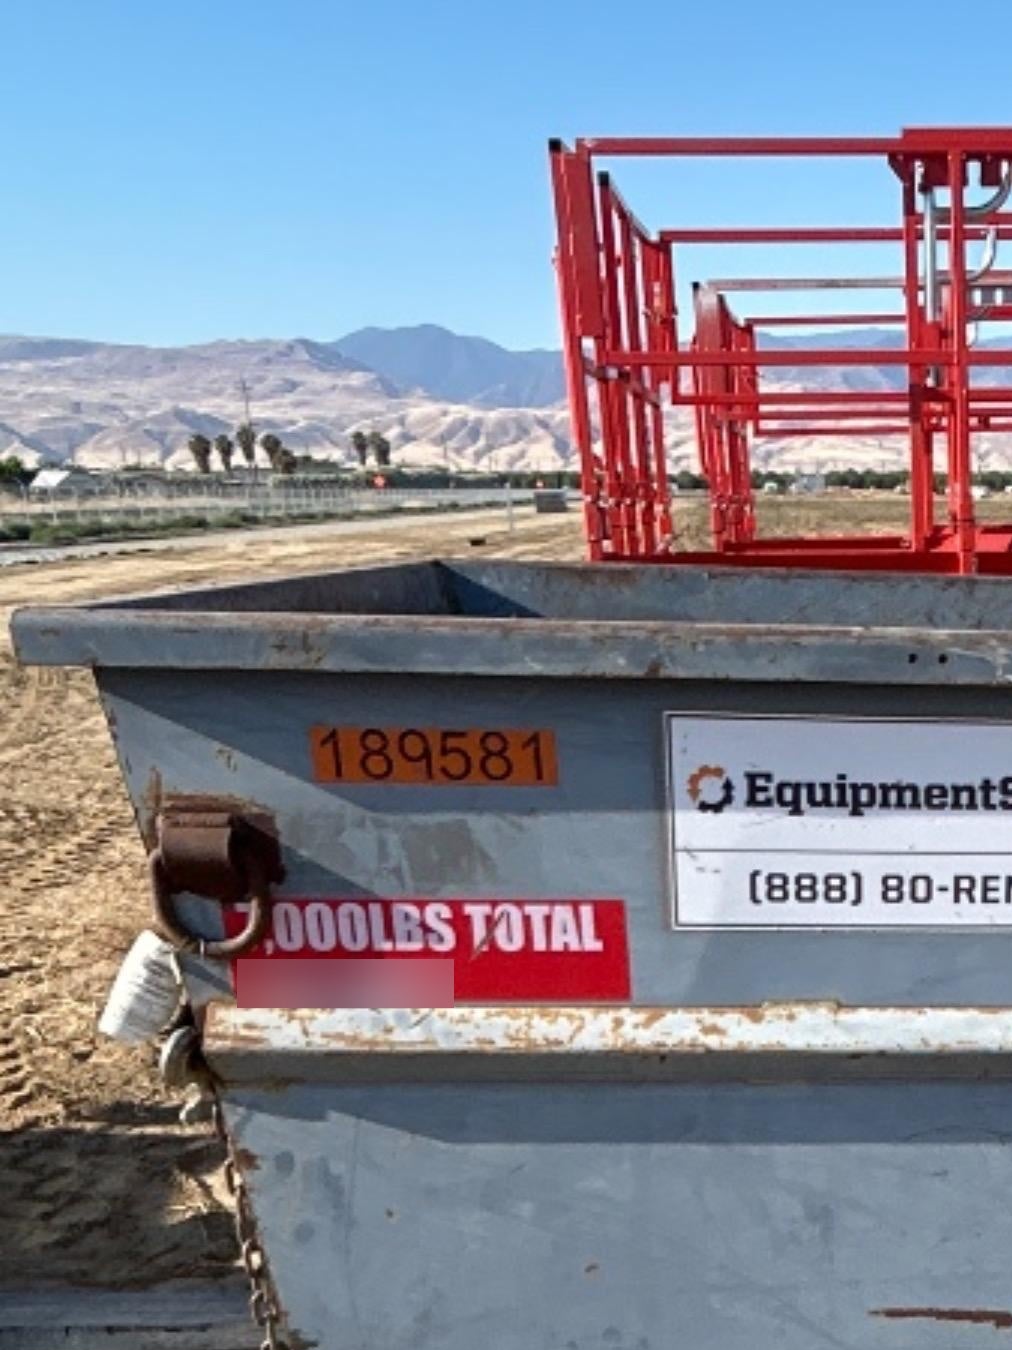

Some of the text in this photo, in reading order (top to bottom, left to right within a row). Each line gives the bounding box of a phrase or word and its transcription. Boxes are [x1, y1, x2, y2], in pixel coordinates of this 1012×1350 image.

[318, 727, 546, 782] 189581
[748, 869, 863, 905] (888)
[463, 903, 604, 953] TOTAL
